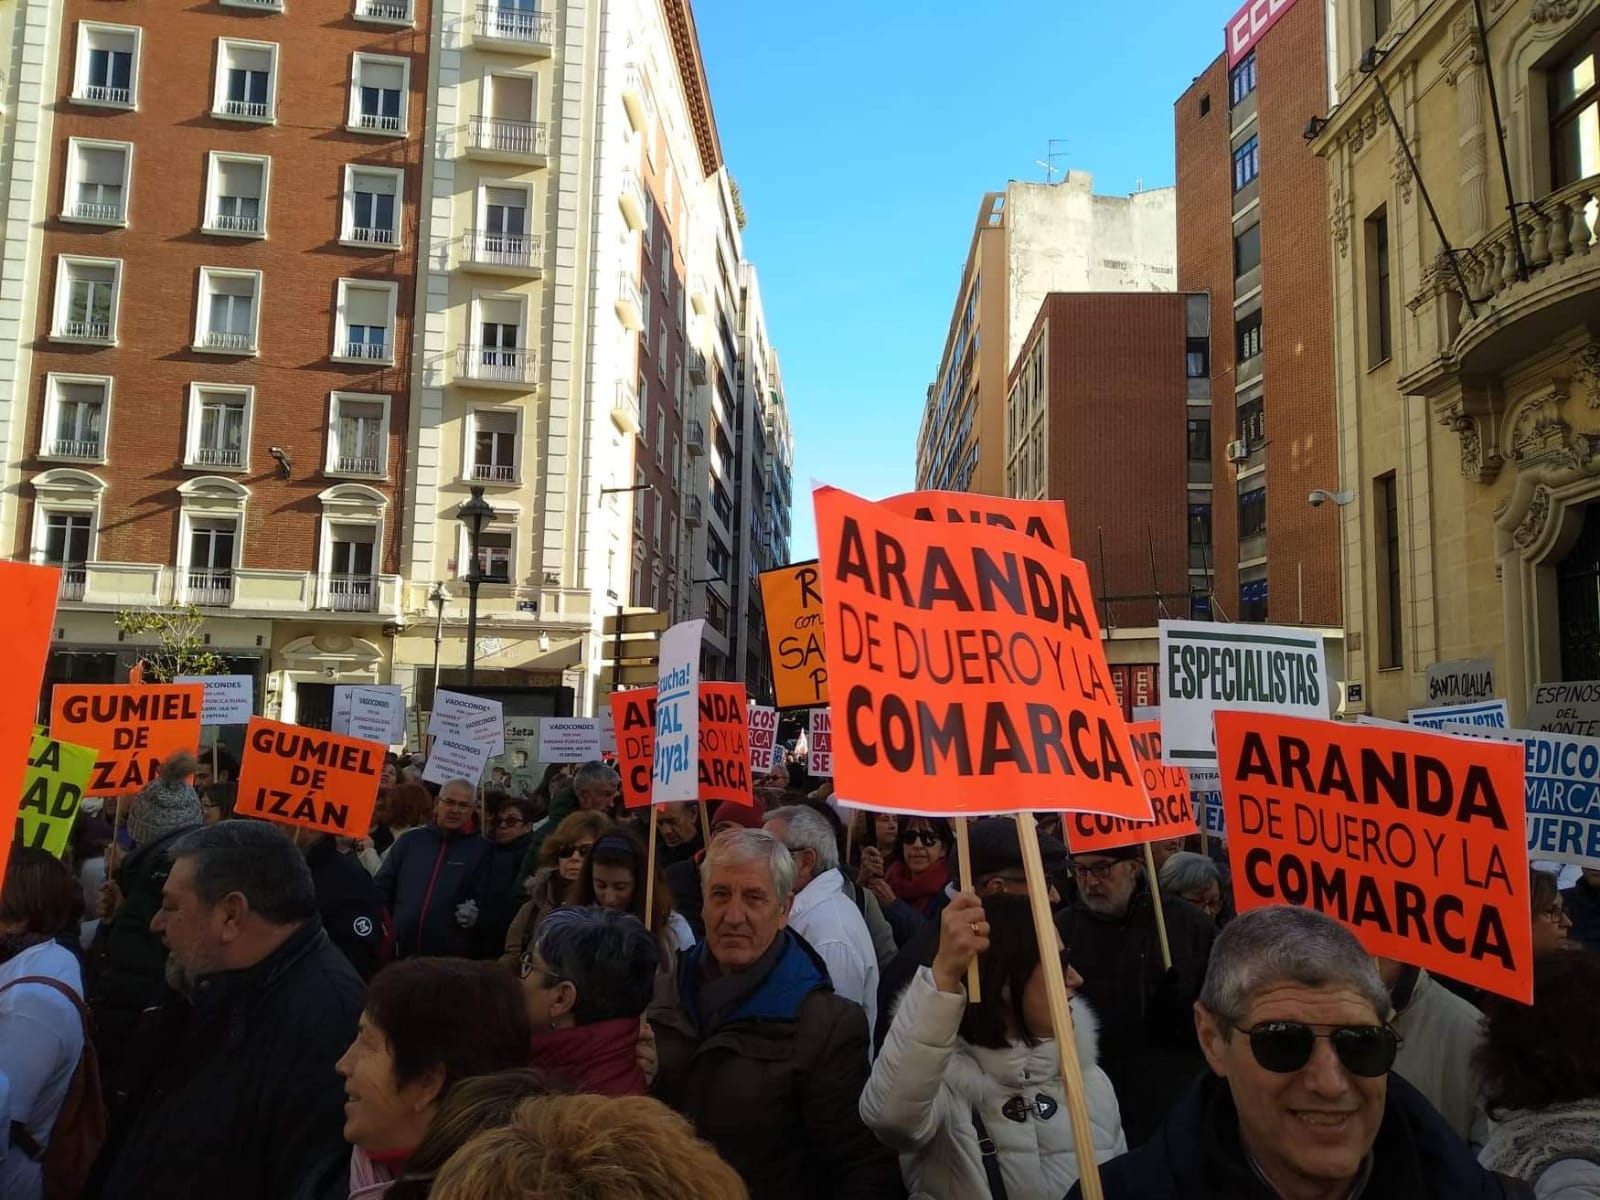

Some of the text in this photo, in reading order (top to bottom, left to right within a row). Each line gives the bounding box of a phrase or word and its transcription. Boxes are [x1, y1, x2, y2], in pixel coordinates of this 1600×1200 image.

[836, 516, 1092, 641] ARANDA
[326, 666, 335, 678] 3
[839, 602, 884, 673] DE
[894, 622, 1043, 686] DUERO
[1043, 636, 1066, 691] Y
[1072, 645, 1112, 706] LA
[1167, 645, 1320, 706] ESPECIALISTAS
[62, 694, 197, 724] GUMIEL
[1556, 707, 1579, 719] DEL
[113, 726, 150, 750] DE
[252, 728, 376, 776] GUMIEL
[625, 735, 652, 760] DE
[846, 685, 1134, 787] COMARCA
[290, 764, 327, 790] DE
[1236, 731, 1509, 831] ARANDA
[255, 787, 349, 829] IZÁN
[1237, 794, 1515, 896] DE DUERO Y LA
[1244, 847, 1516, 972] COMARCA
